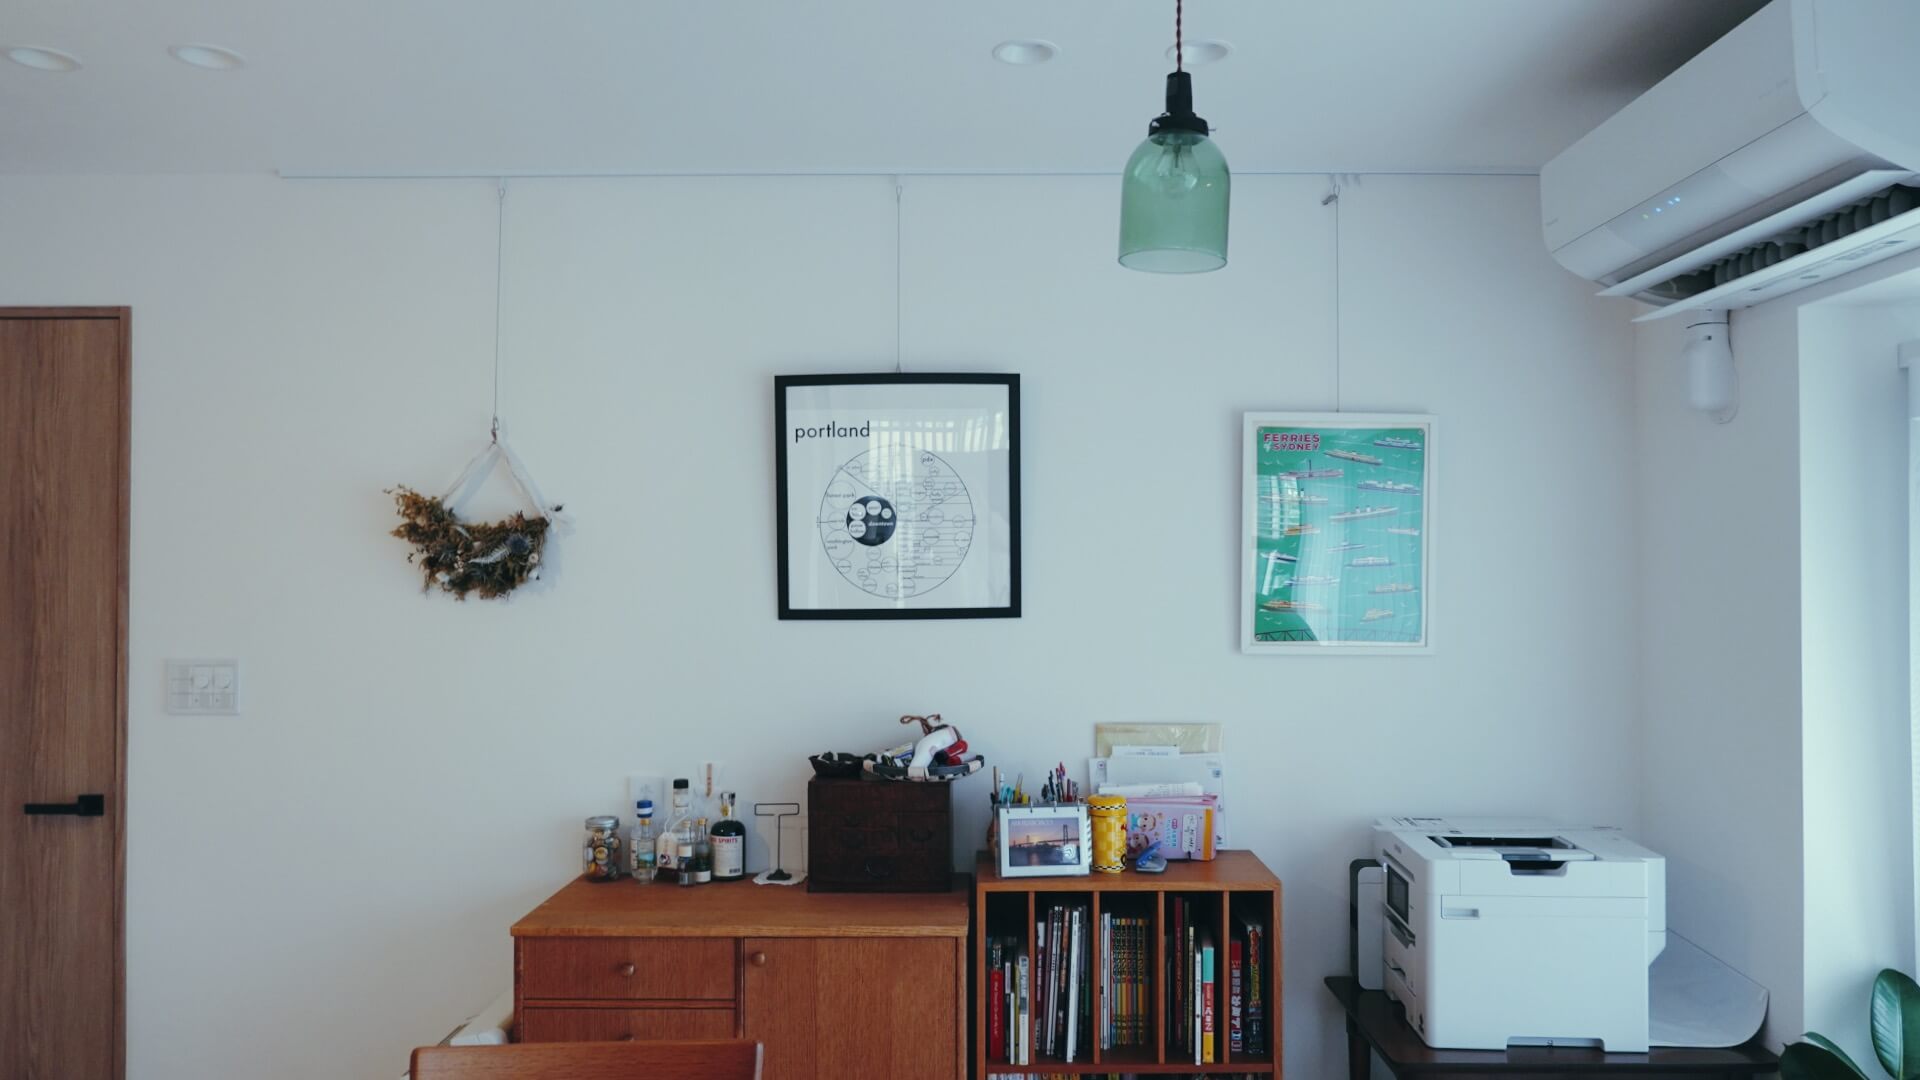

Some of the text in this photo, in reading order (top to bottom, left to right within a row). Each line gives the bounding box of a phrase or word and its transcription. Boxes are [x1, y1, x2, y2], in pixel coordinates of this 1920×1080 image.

[795, 420, 870, 444] portland
[1263, 433, 1320, 442] FERRIES
[1272, 443, 1320, 451] SYDNEY
